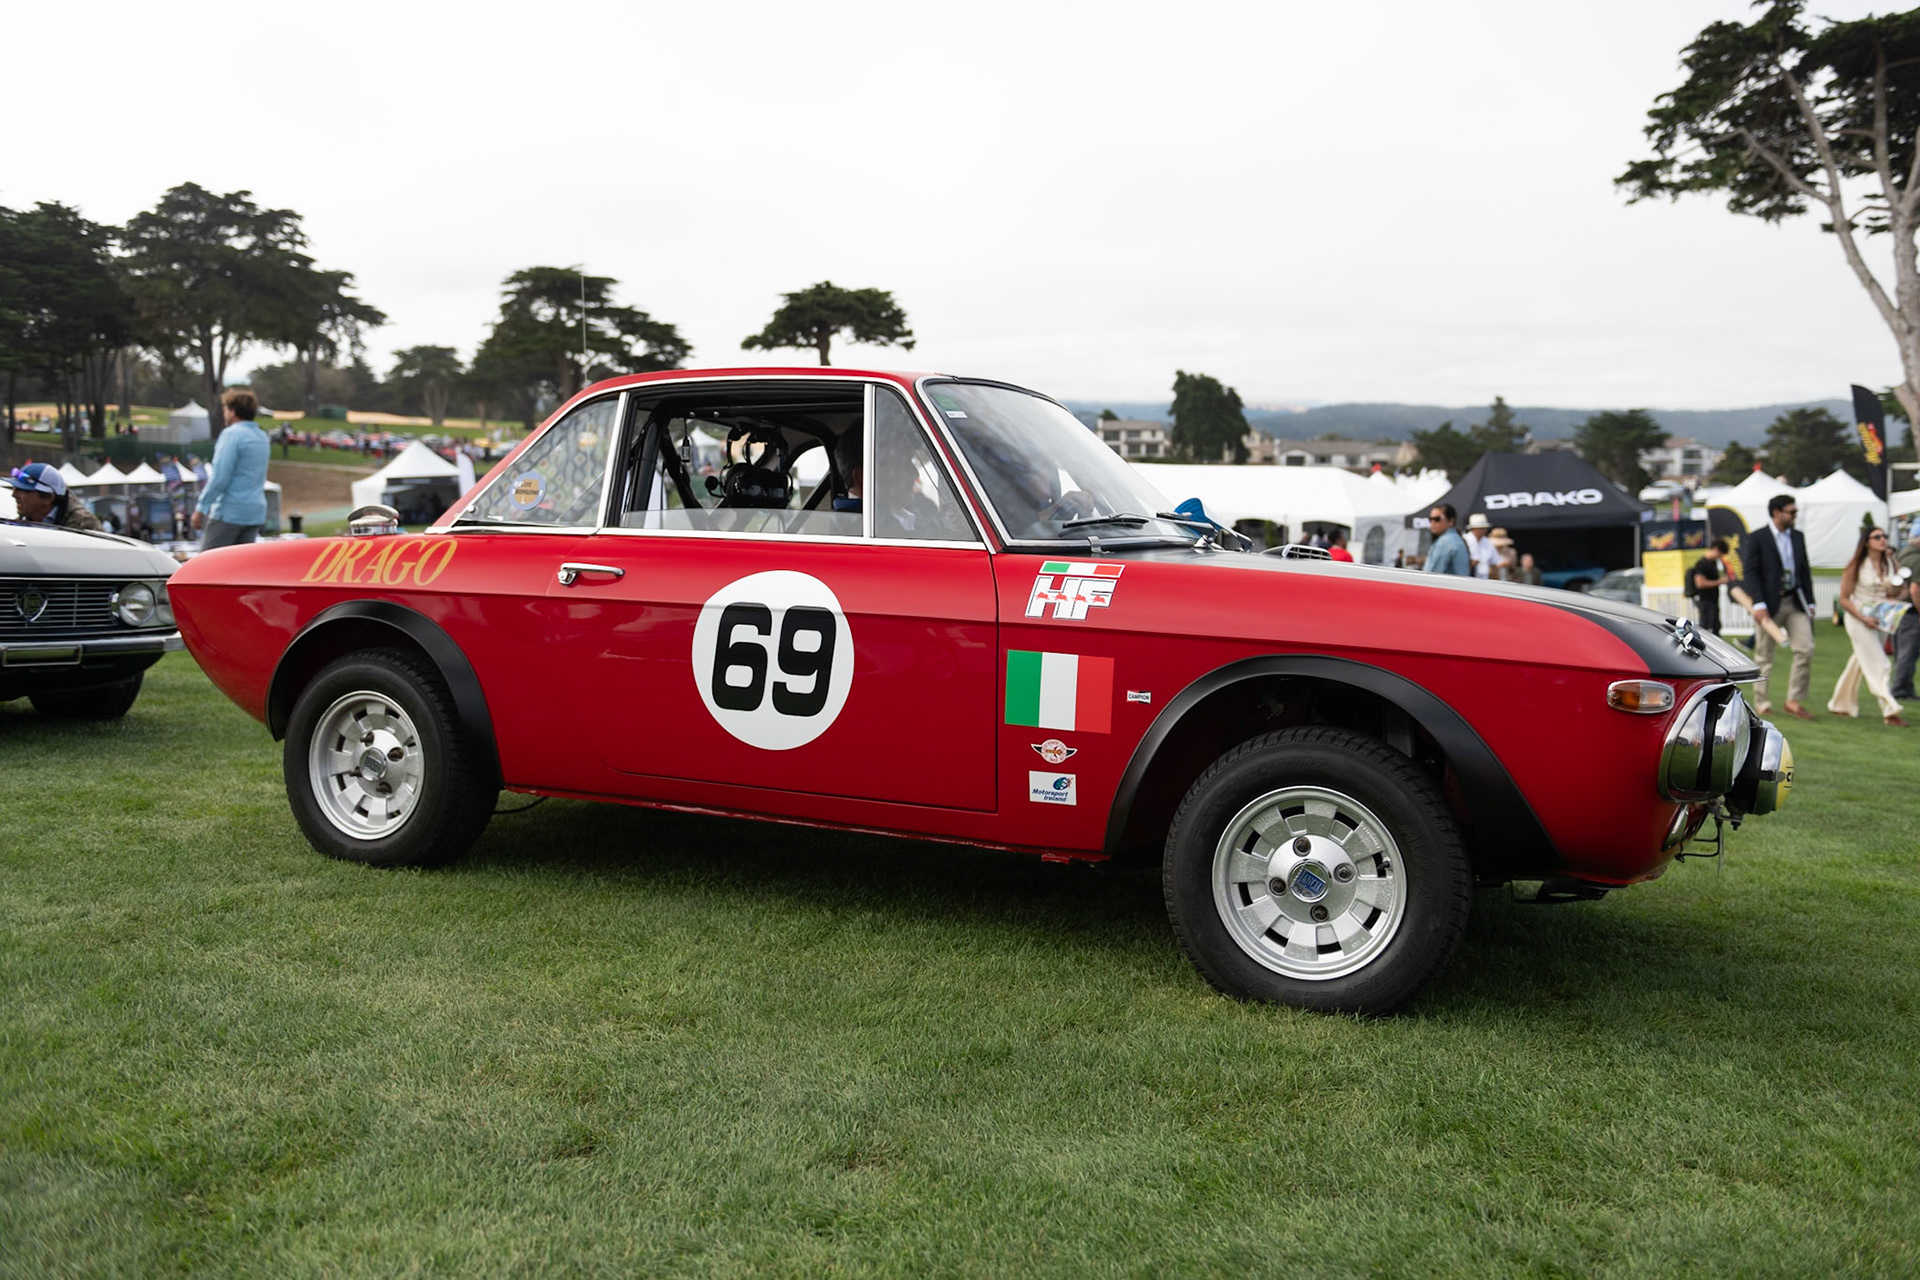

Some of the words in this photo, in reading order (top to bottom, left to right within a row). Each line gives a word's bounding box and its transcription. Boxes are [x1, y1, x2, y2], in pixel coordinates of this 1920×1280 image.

[1484, 488, 1603, 510] DRAKO
[300, 539, 458, 586] DRAGO
[1025, 575, 1118, 621] HF
[712, 602, 837, 717] 69
[1032, 788, 1068, 797] Motorsport
